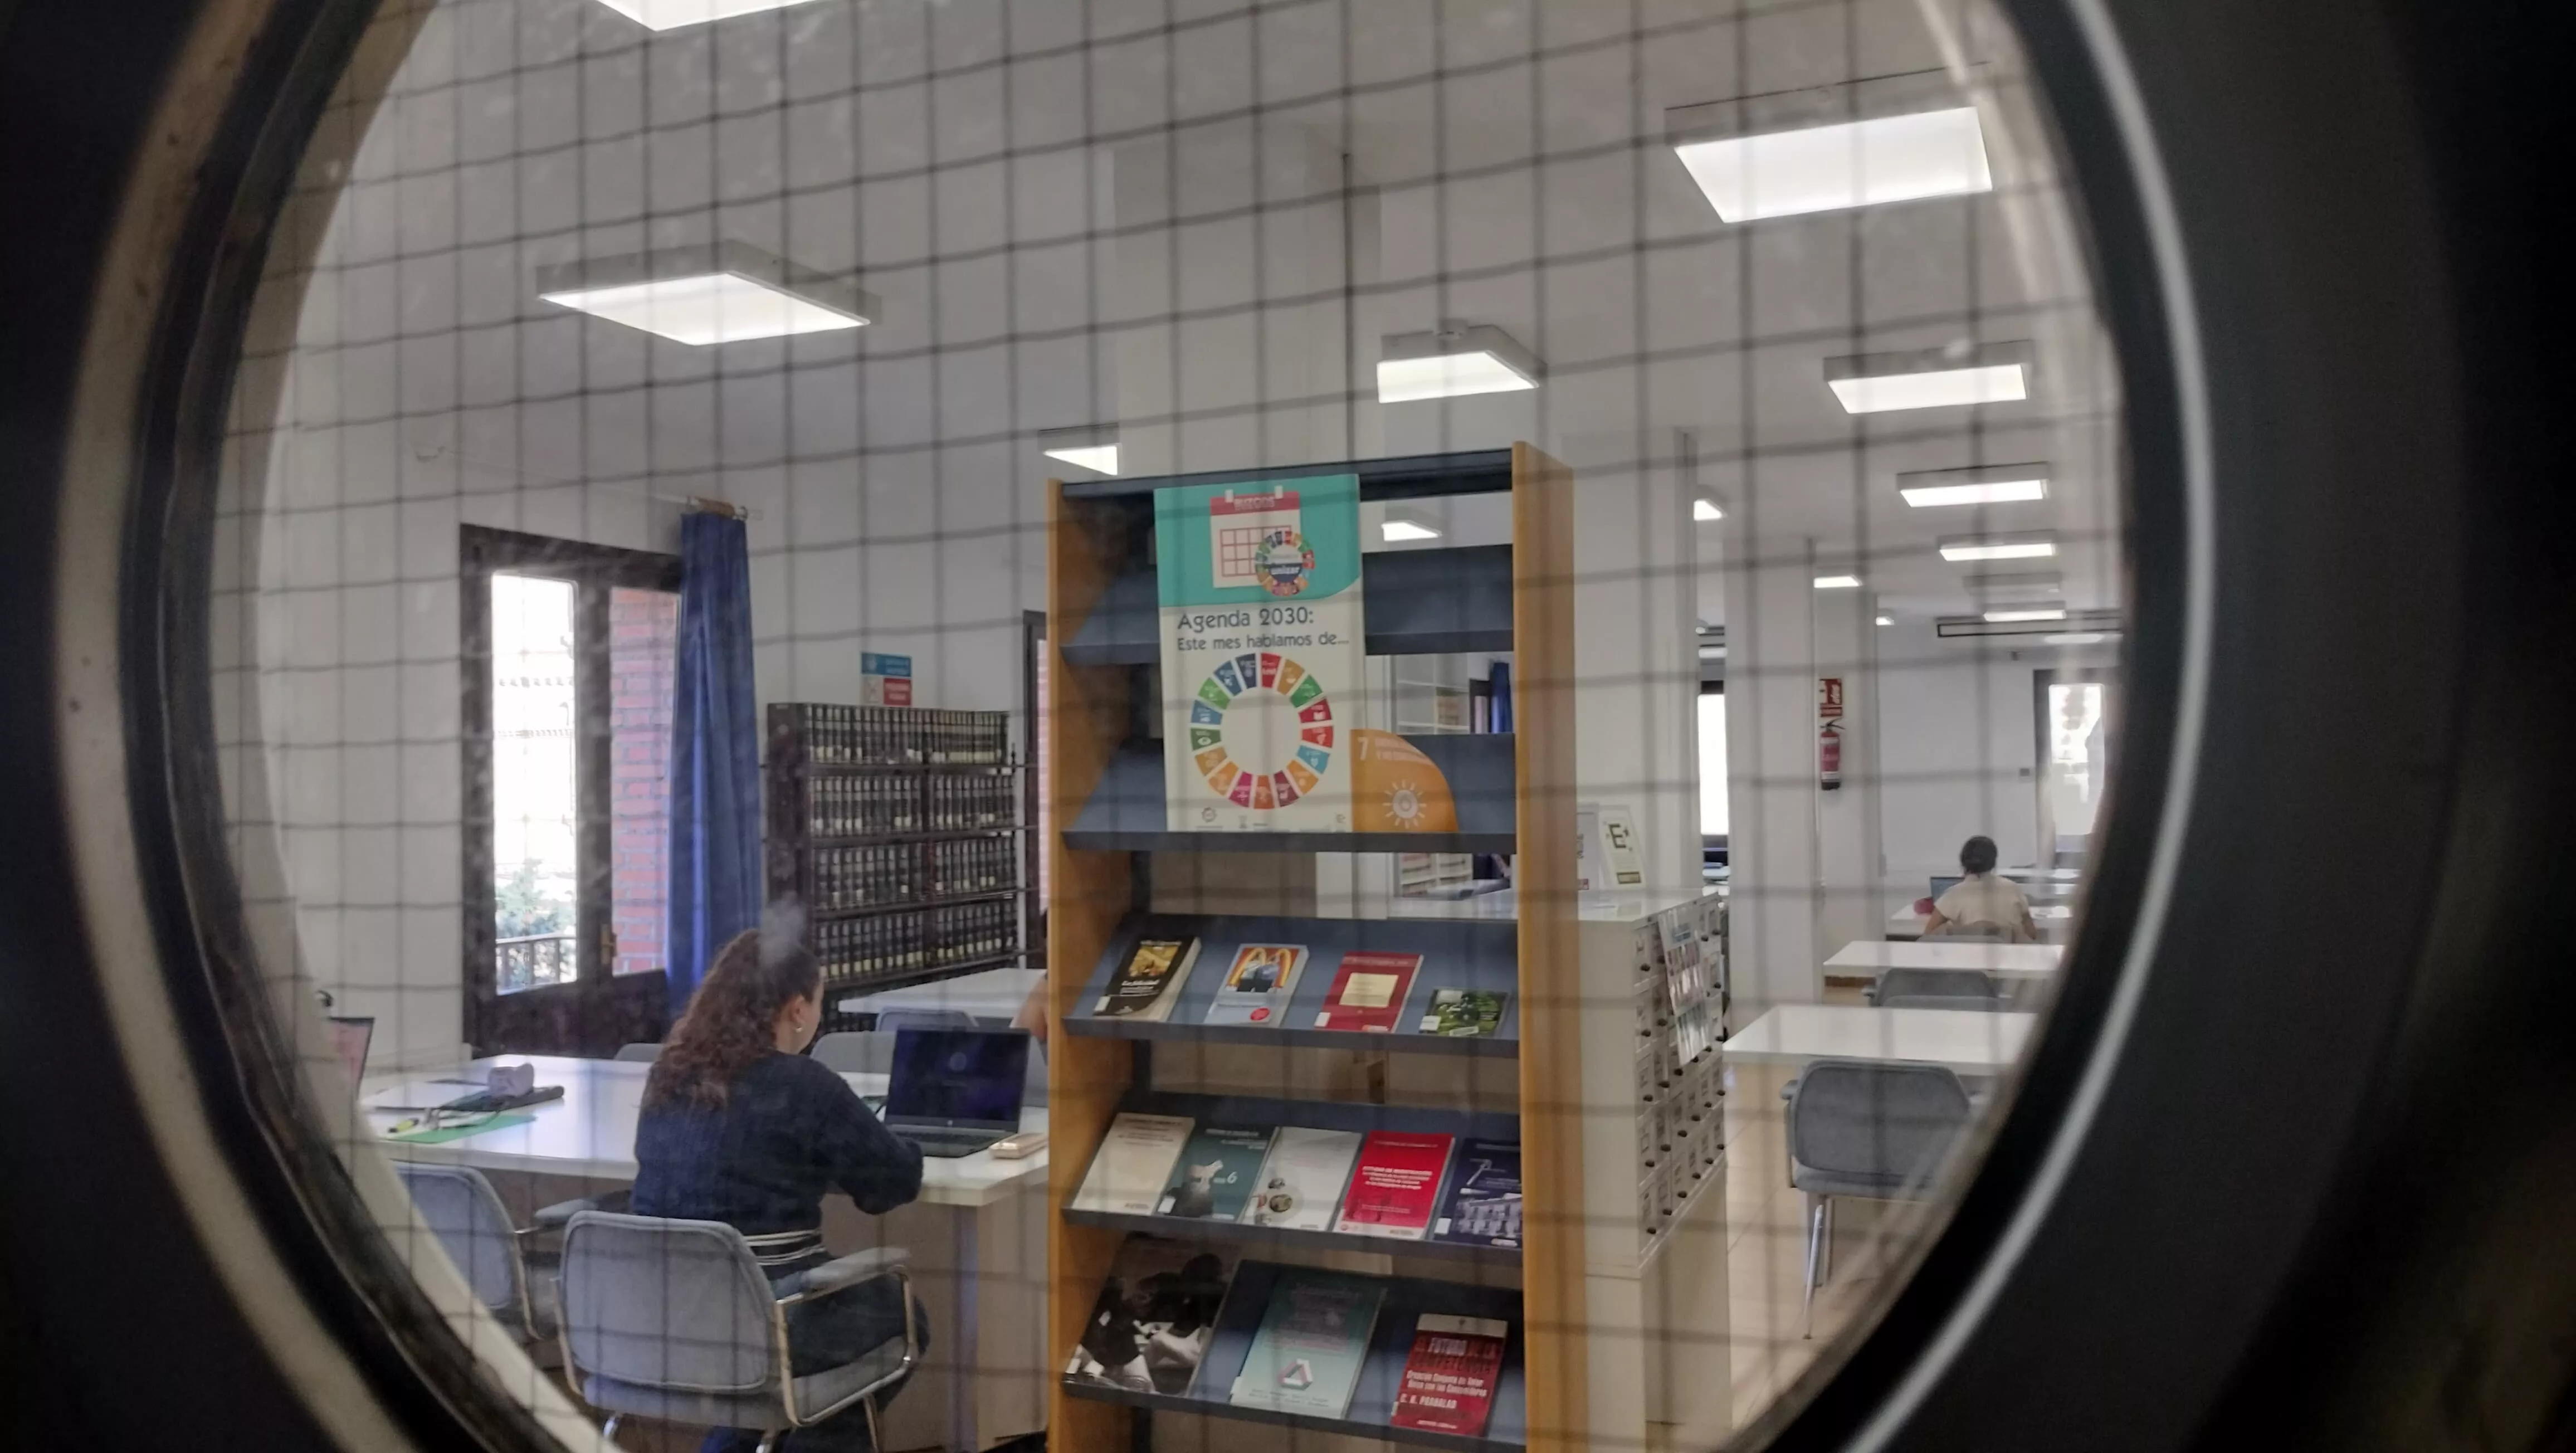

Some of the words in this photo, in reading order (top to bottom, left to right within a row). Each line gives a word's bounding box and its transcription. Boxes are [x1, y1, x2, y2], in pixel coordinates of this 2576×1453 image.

[1177, 611, 1250, 633] Agenda
[1259, 607, 1314, 626] 2030:
[1177, 637, 1206, 651] Este
[1213, 637, 1241, 650] mes
[1247, 634, 1312, 648] hablamos
[1318, 632, 1349, 645] de...
[1357, 737, 1368, 761] 7
[1227, 1171, 1237, 1184] 6
